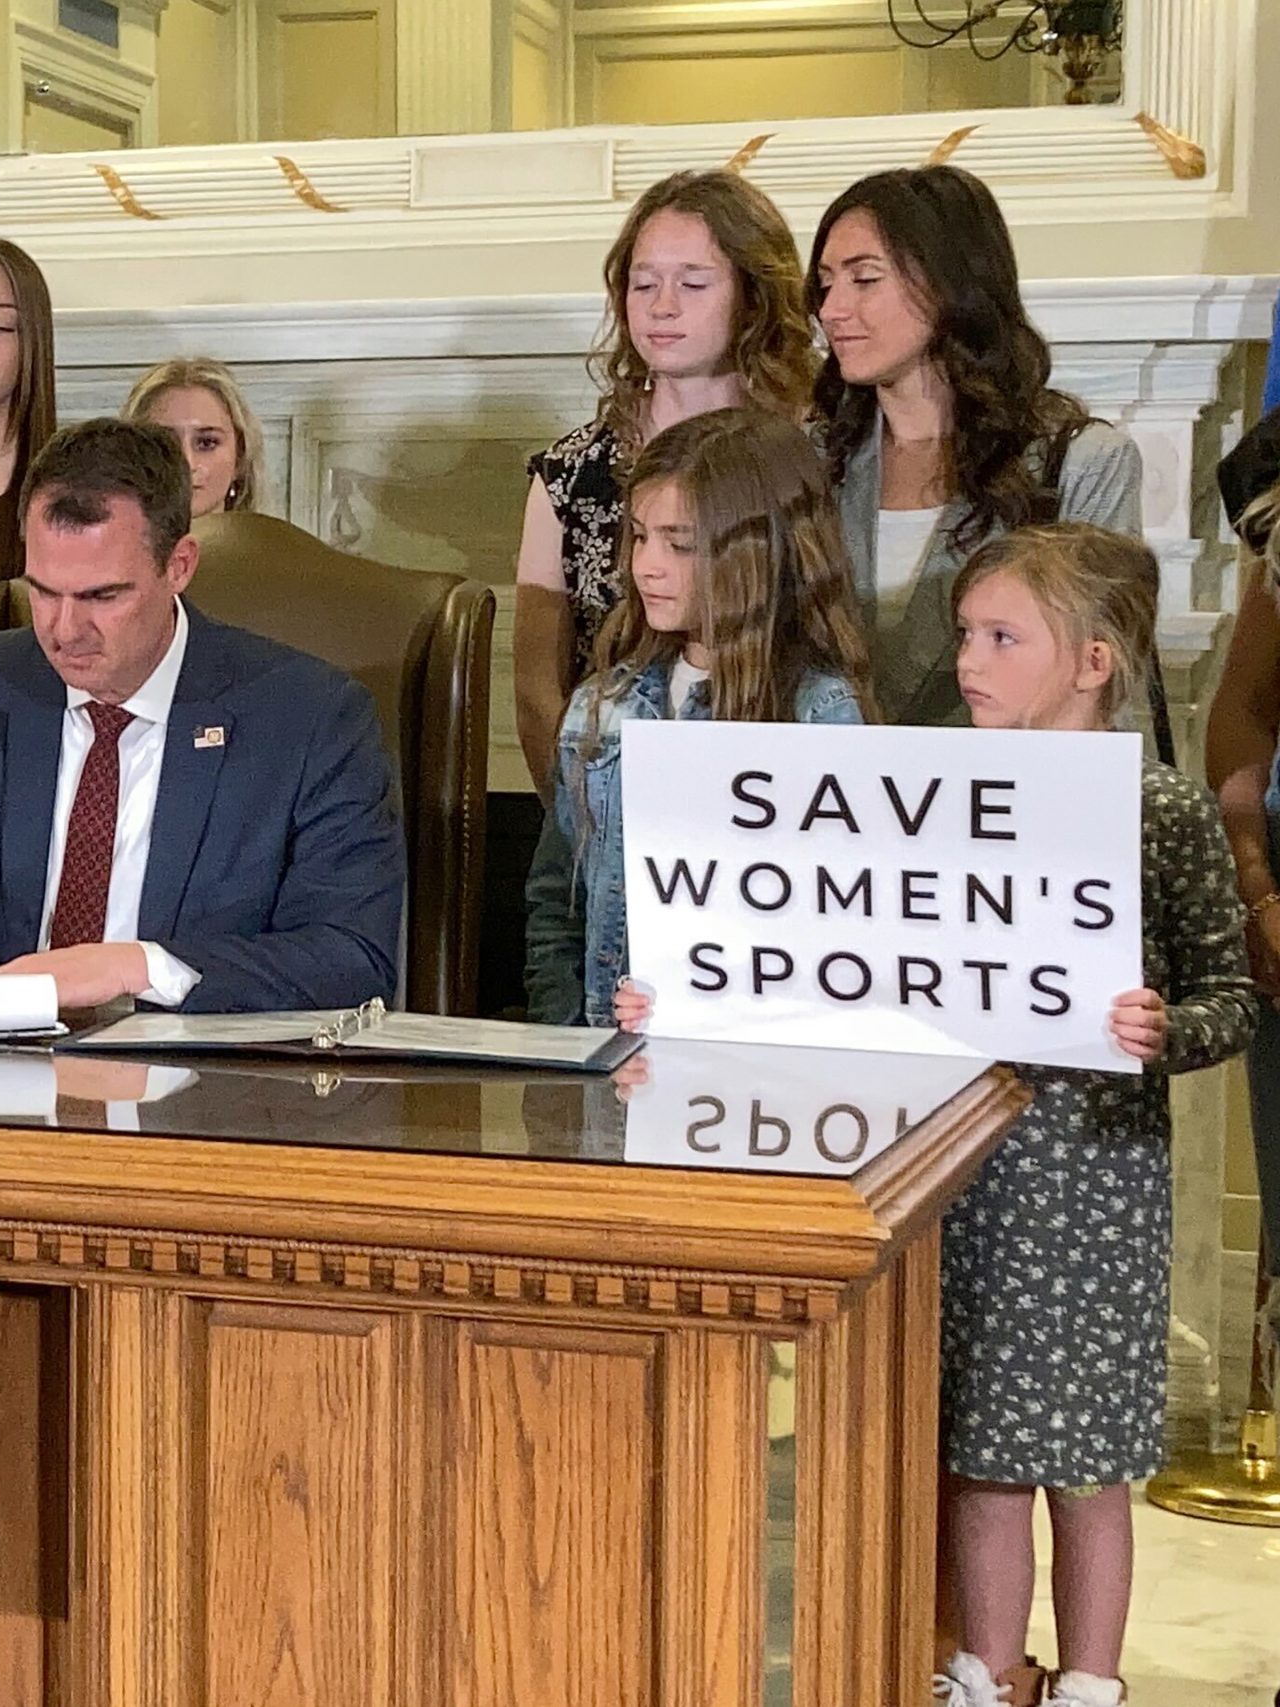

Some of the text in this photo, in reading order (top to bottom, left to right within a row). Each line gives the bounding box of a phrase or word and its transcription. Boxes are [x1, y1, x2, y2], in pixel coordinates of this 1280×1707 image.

[731, 770, 1017, 841] SAVE
[644, 857, 1115, 931] WOMEN'S
[689, 942, 1071, 1017] SPORTS
